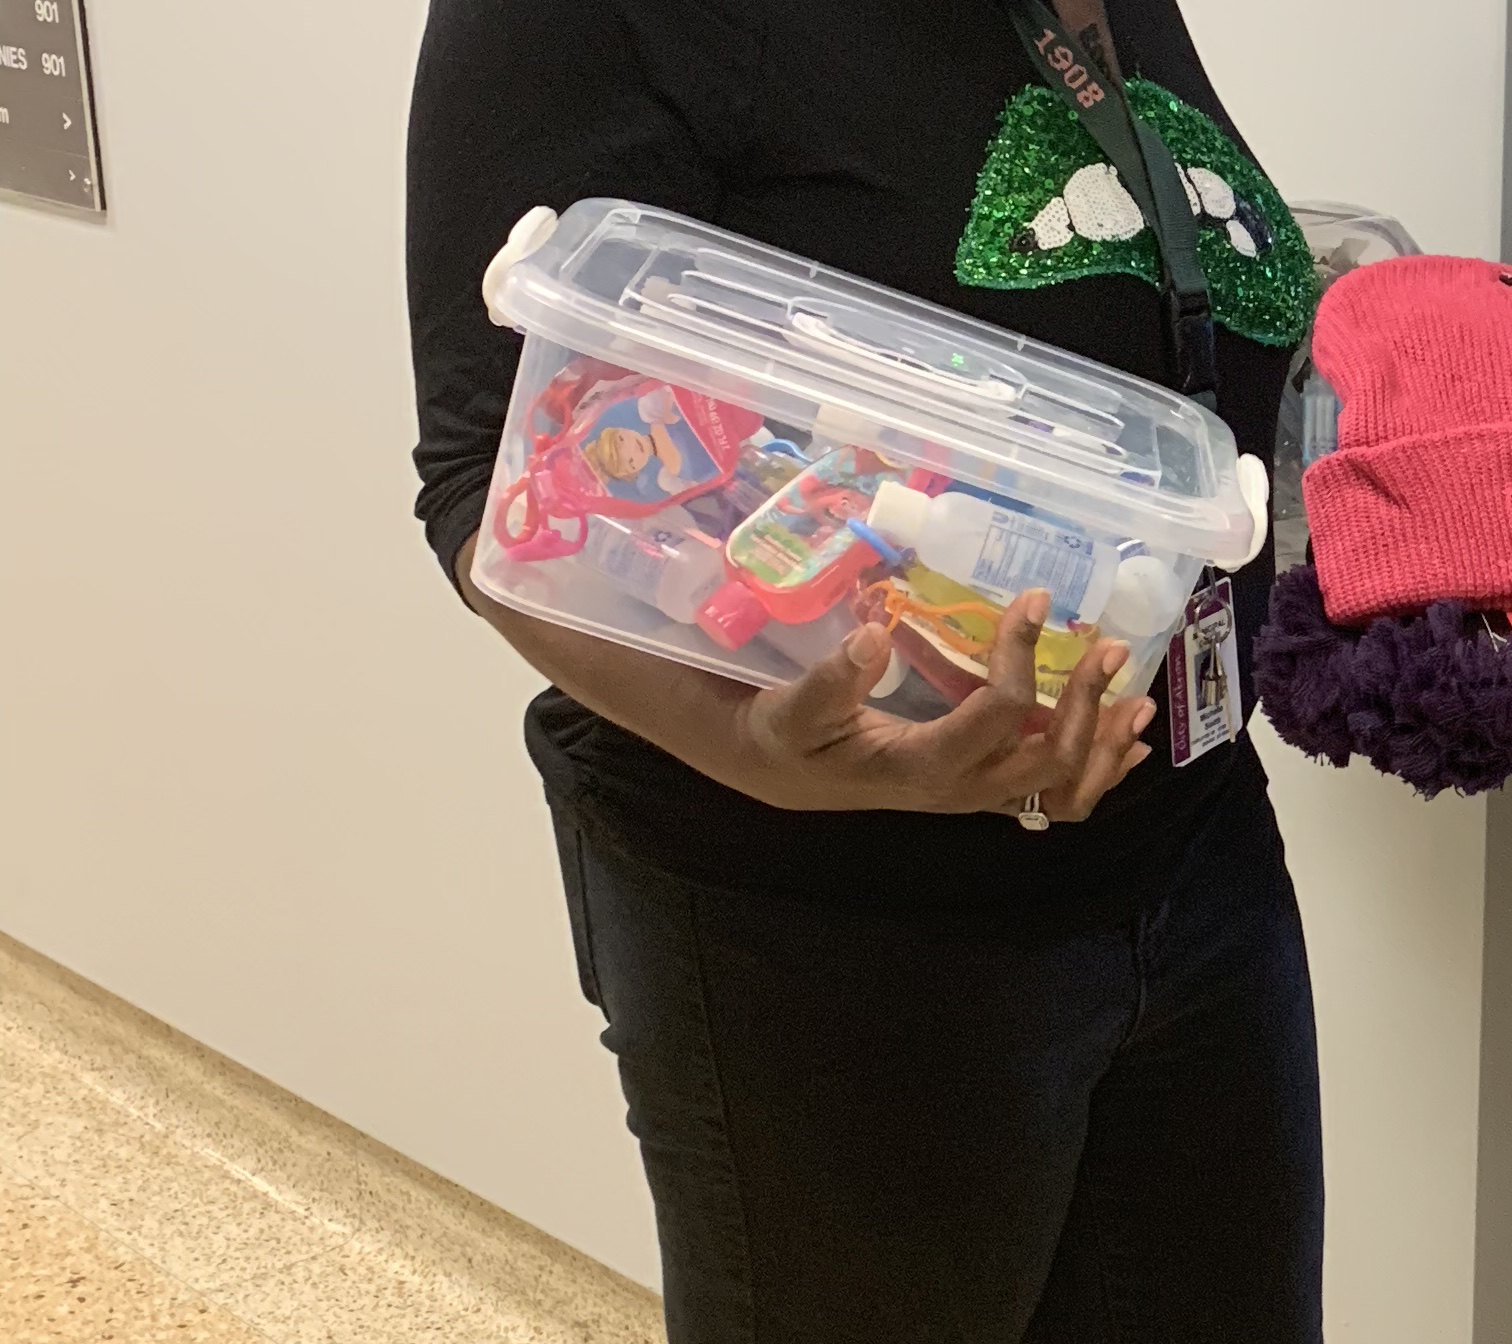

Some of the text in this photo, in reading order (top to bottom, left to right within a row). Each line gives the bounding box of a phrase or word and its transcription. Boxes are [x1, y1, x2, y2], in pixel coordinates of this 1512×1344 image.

[34, 0, 60, 24] 901
[41, 52, 66, 77] 901
[1033, 28, 1105, 109] 1908
